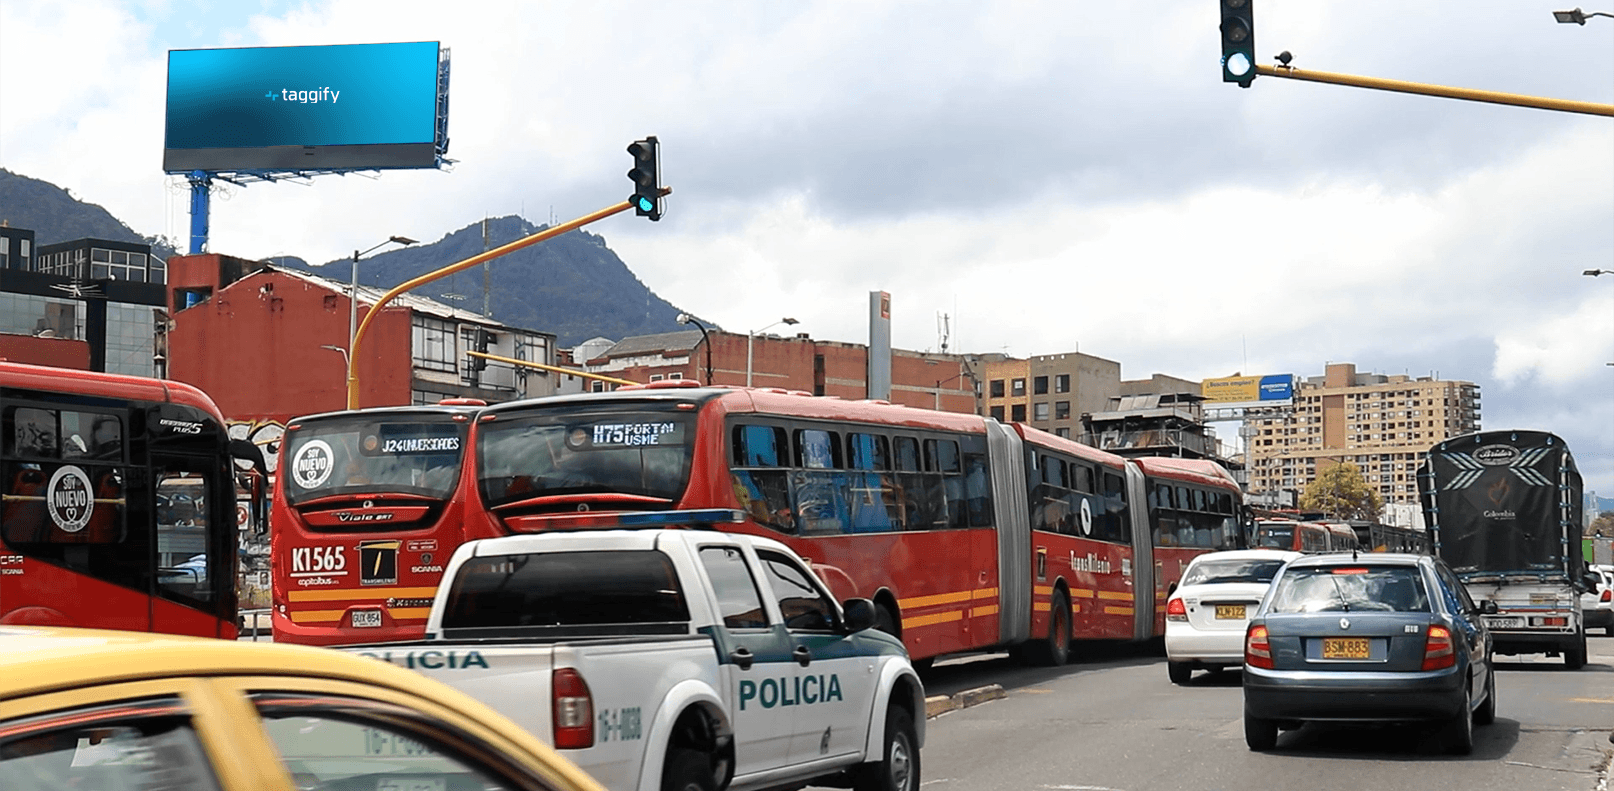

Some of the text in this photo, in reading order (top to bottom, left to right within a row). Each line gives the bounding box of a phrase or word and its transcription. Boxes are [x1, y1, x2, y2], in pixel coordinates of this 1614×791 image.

[281, 86, 340, 104] taggify
[593, 424, 624, 443] H75
[624, 433, 659, 446] USME
[307, 448, 320, 459] SOY
[382, 440, 403, 453] J24
[299, 457, 326, 471] NUEVO
[62, 476, 76, 490] SOY
[55, 490, 86, 508] NUEVO
[1483, 509, 1516, 518] Colombia
[292, 546, 345, 572] K1565
[411, 565, 443, 574] SCANIA
[359, 651, 489, 669] ICIA
[739, 674, 843, 711] POLICIA
